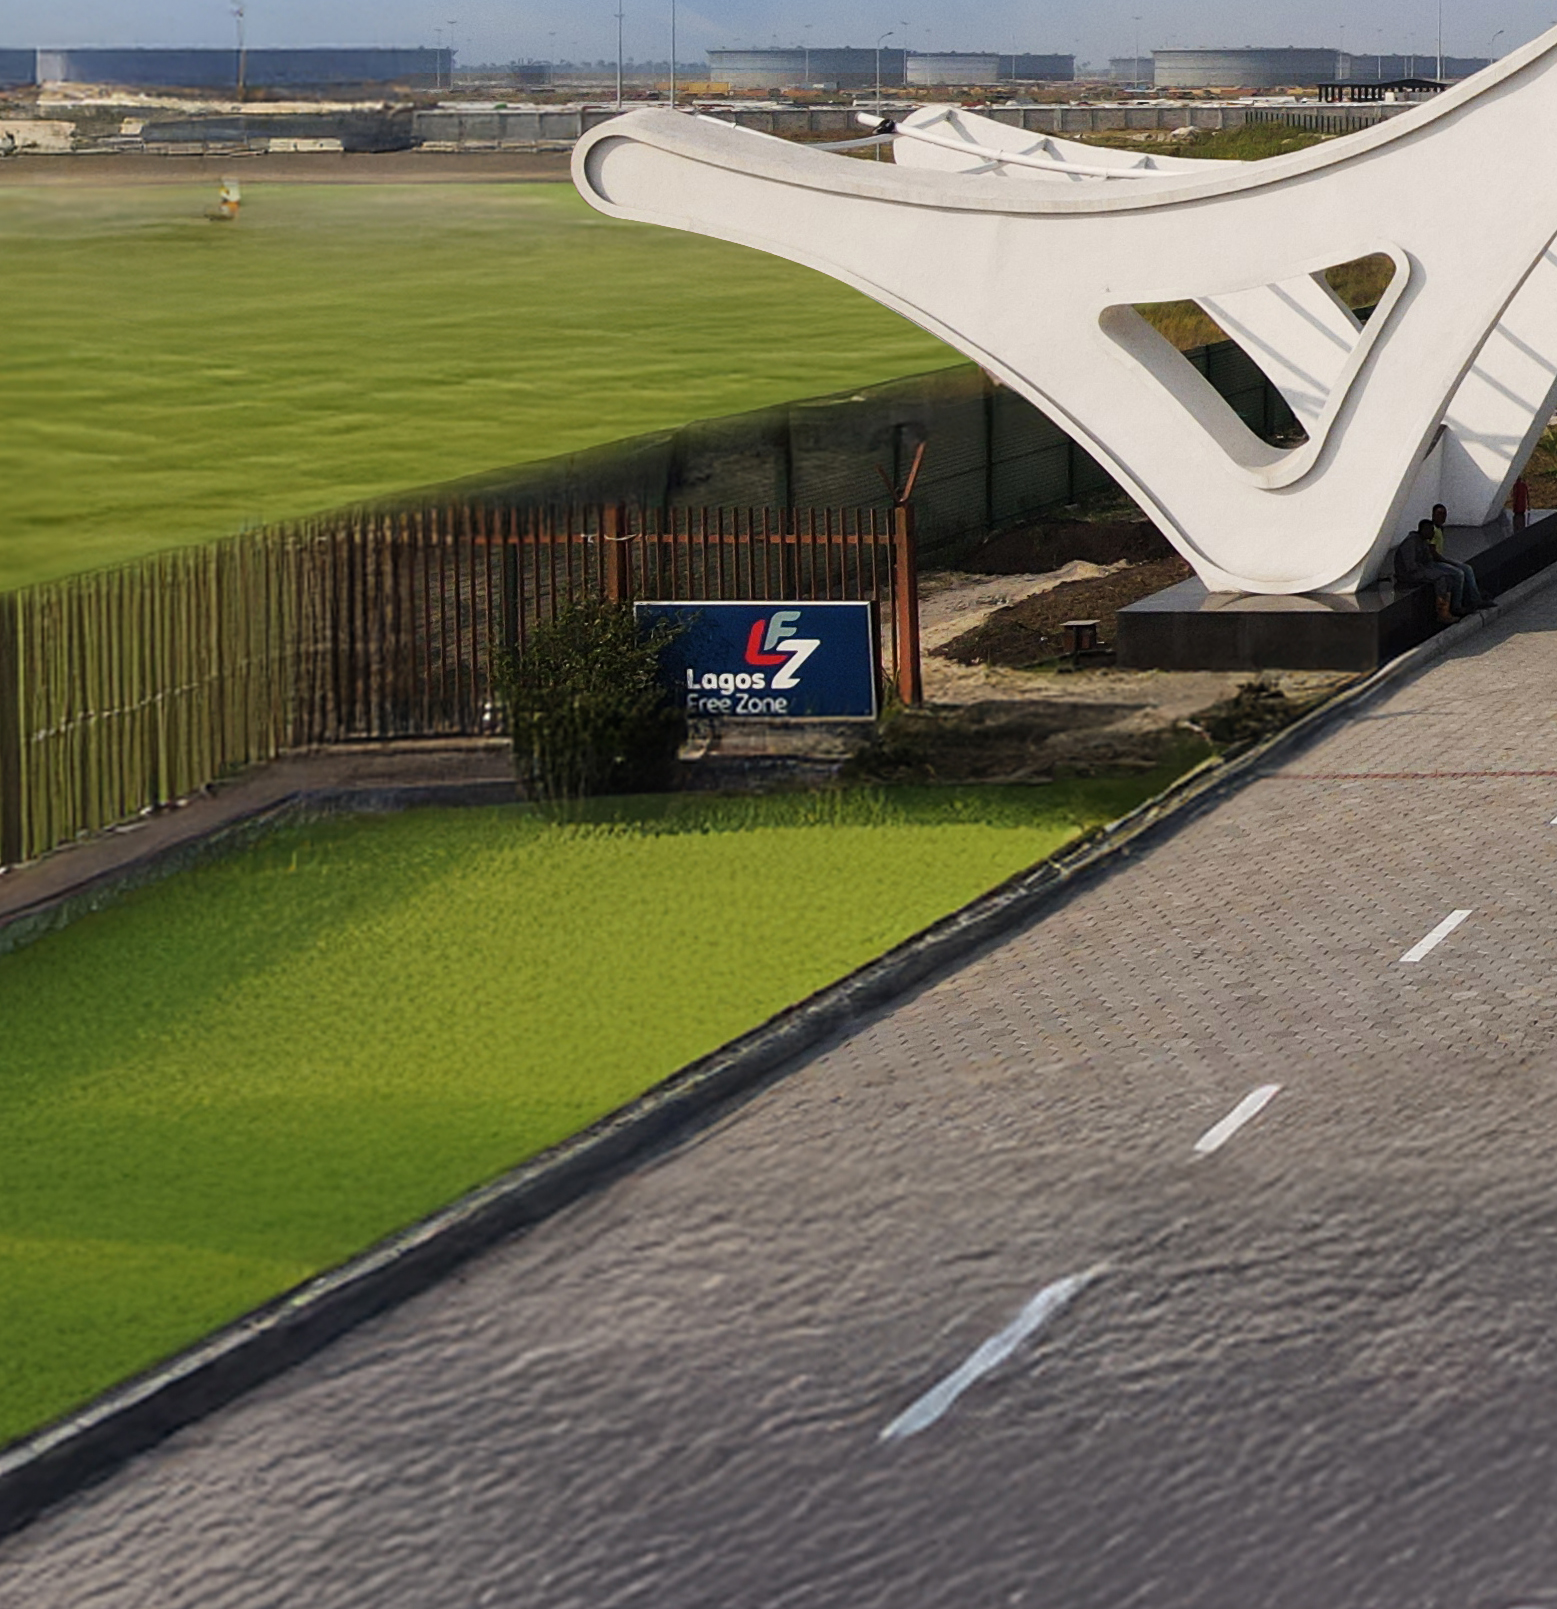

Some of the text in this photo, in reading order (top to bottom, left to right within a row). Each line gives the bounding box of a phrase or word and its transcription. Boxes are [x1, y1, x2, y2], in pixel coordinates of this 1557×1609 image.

[686, 668, 766, 695] Lagos
[686, 693, 788, 714] Free Zone
